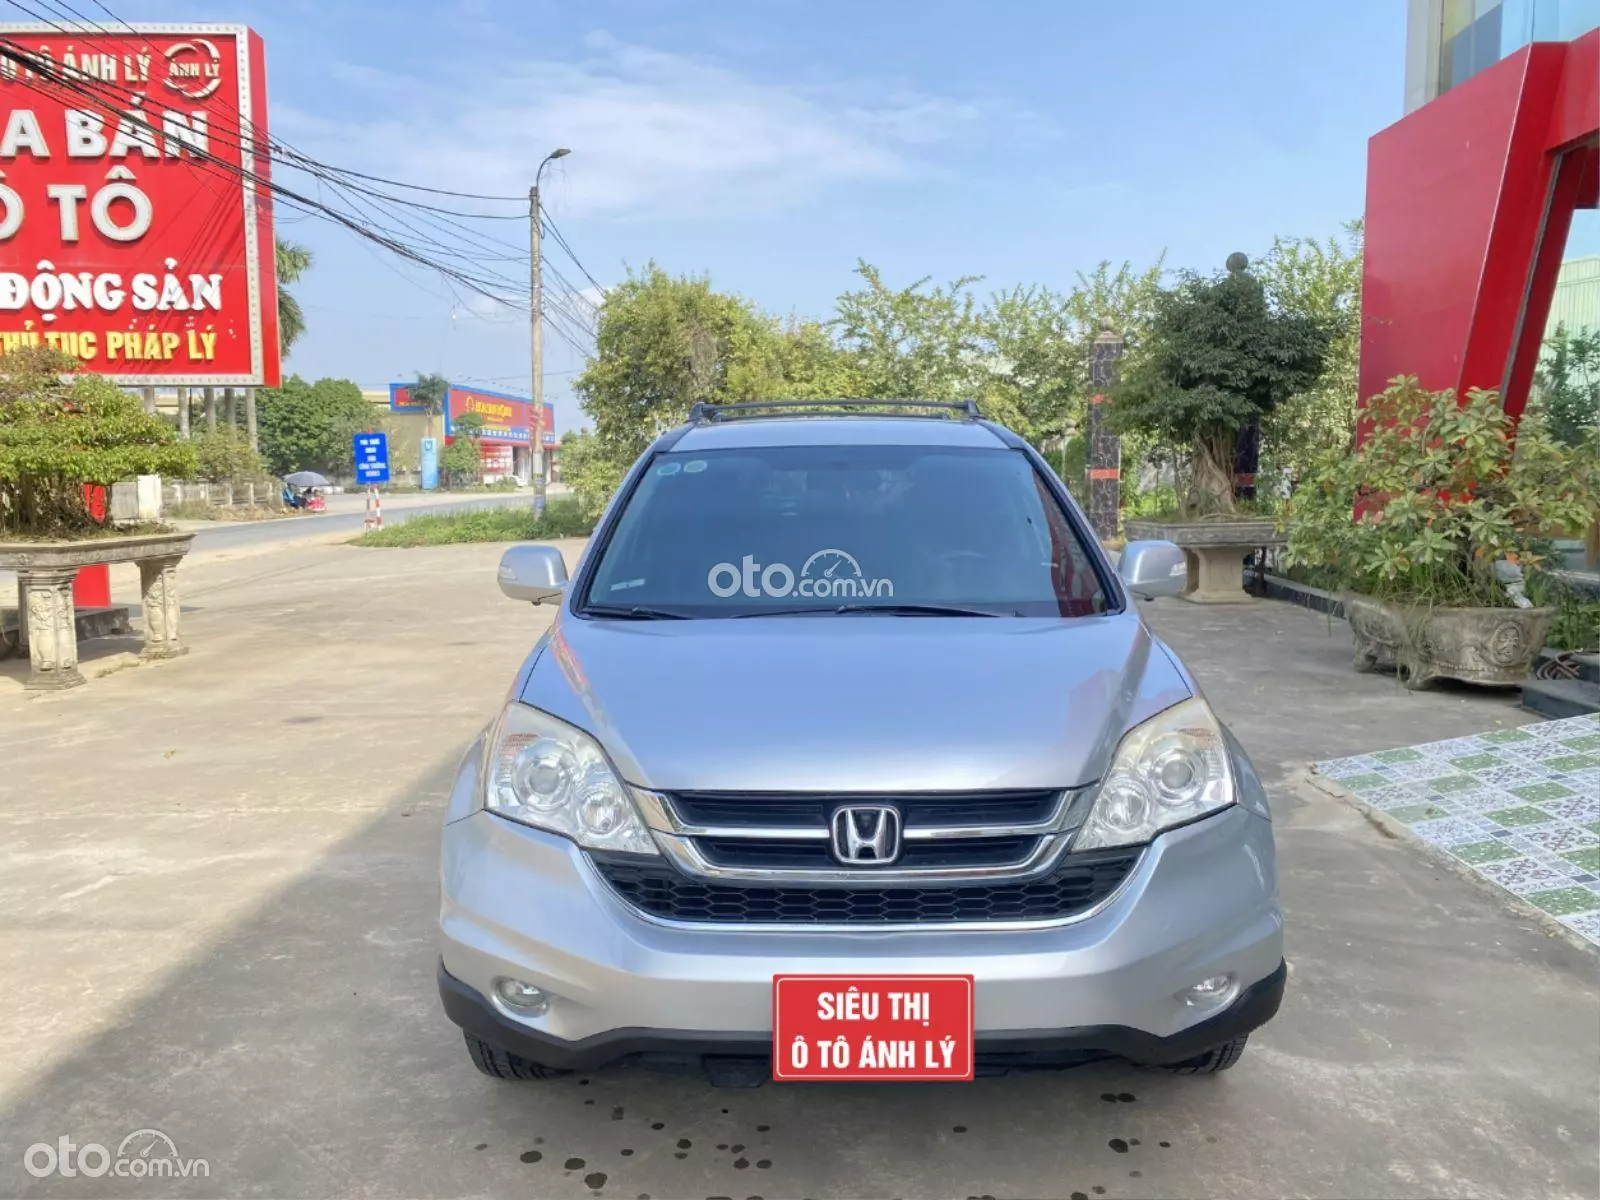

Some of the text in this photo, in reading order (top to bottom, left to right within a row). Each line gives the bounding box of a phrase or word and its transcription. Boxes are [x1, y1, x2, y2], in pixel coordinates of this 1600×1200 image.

[62, 45, 117, 81] ÁNH
[124, 46, 152, 81] LÝ
[65, 92, 208, 158] BÁN
[48, 165, 153, 242] TÔ
[0, 257, 223, 321] ĐỘNG SẢN
[106, 325, 180, 360] PHÁP
[188, 325, 217, 360] LÝ
[817, 986, 930, 1026] SIÊU THỊ
[791, 1035, 956, 1069] Ô TÔ ÁNH LÝ
